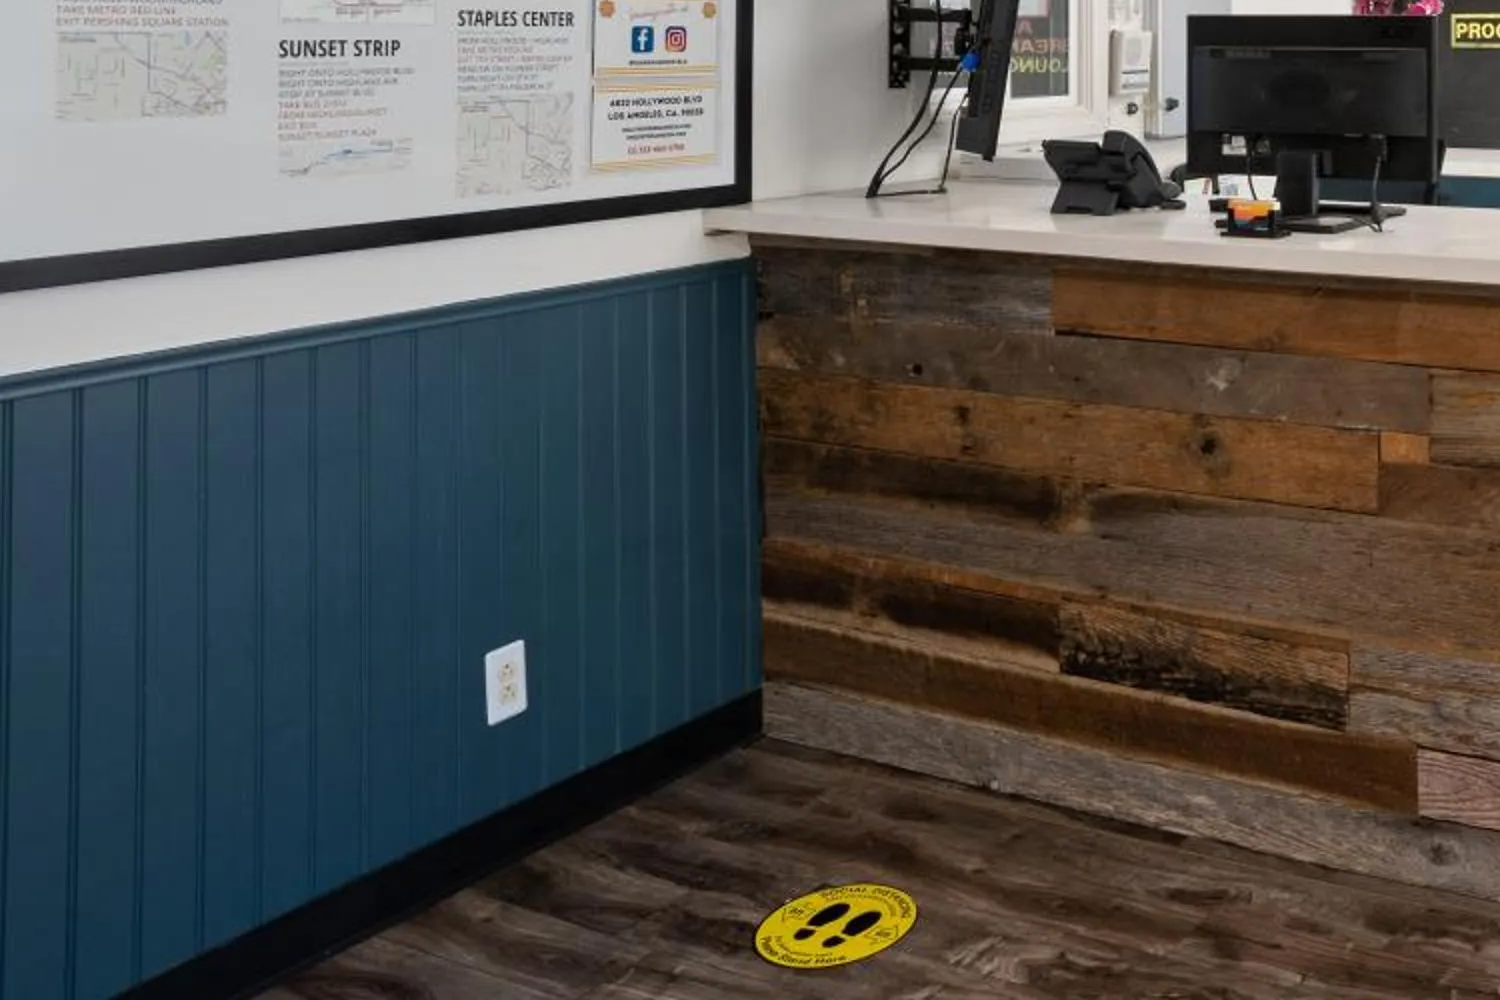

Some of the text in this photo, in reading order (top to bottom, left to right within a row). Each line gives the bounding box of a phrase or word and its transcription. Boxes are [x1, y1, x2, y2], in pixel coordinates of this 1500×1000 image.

[457, 10, 575, 27] STAPLES CENTER
[279, 40, 401, 58] SUNSET STRIP
